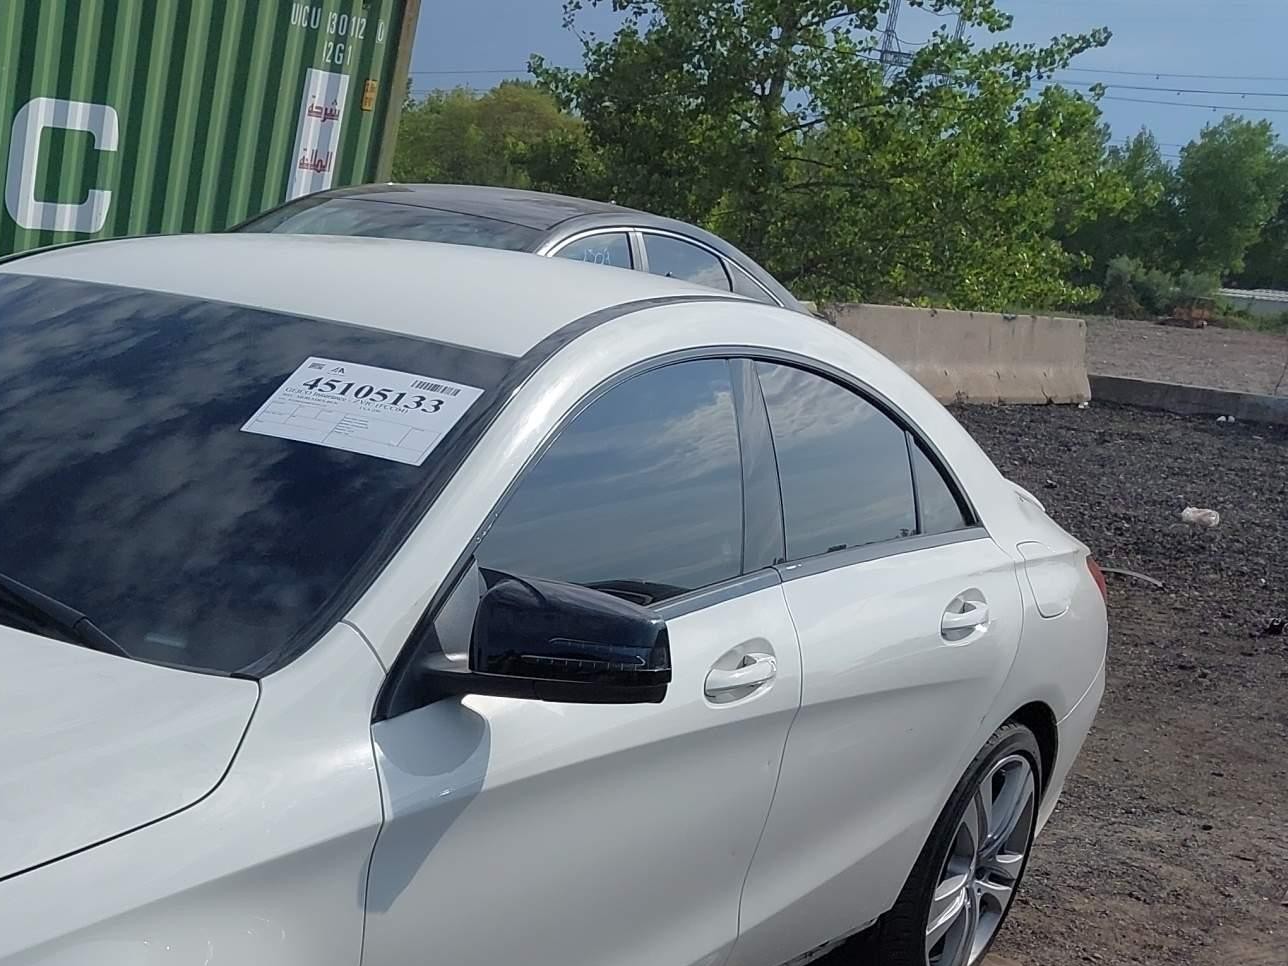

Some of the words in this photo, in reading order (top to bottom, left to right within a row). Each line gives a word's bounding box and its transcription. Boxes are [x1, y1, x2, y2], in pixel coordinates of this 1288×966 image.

[291, 2, 321, 29] UCU
[322, 40, 352, 66] 2G1
[5, 97, 119, 233] C
[303, 376, 444, 414] 45105133
